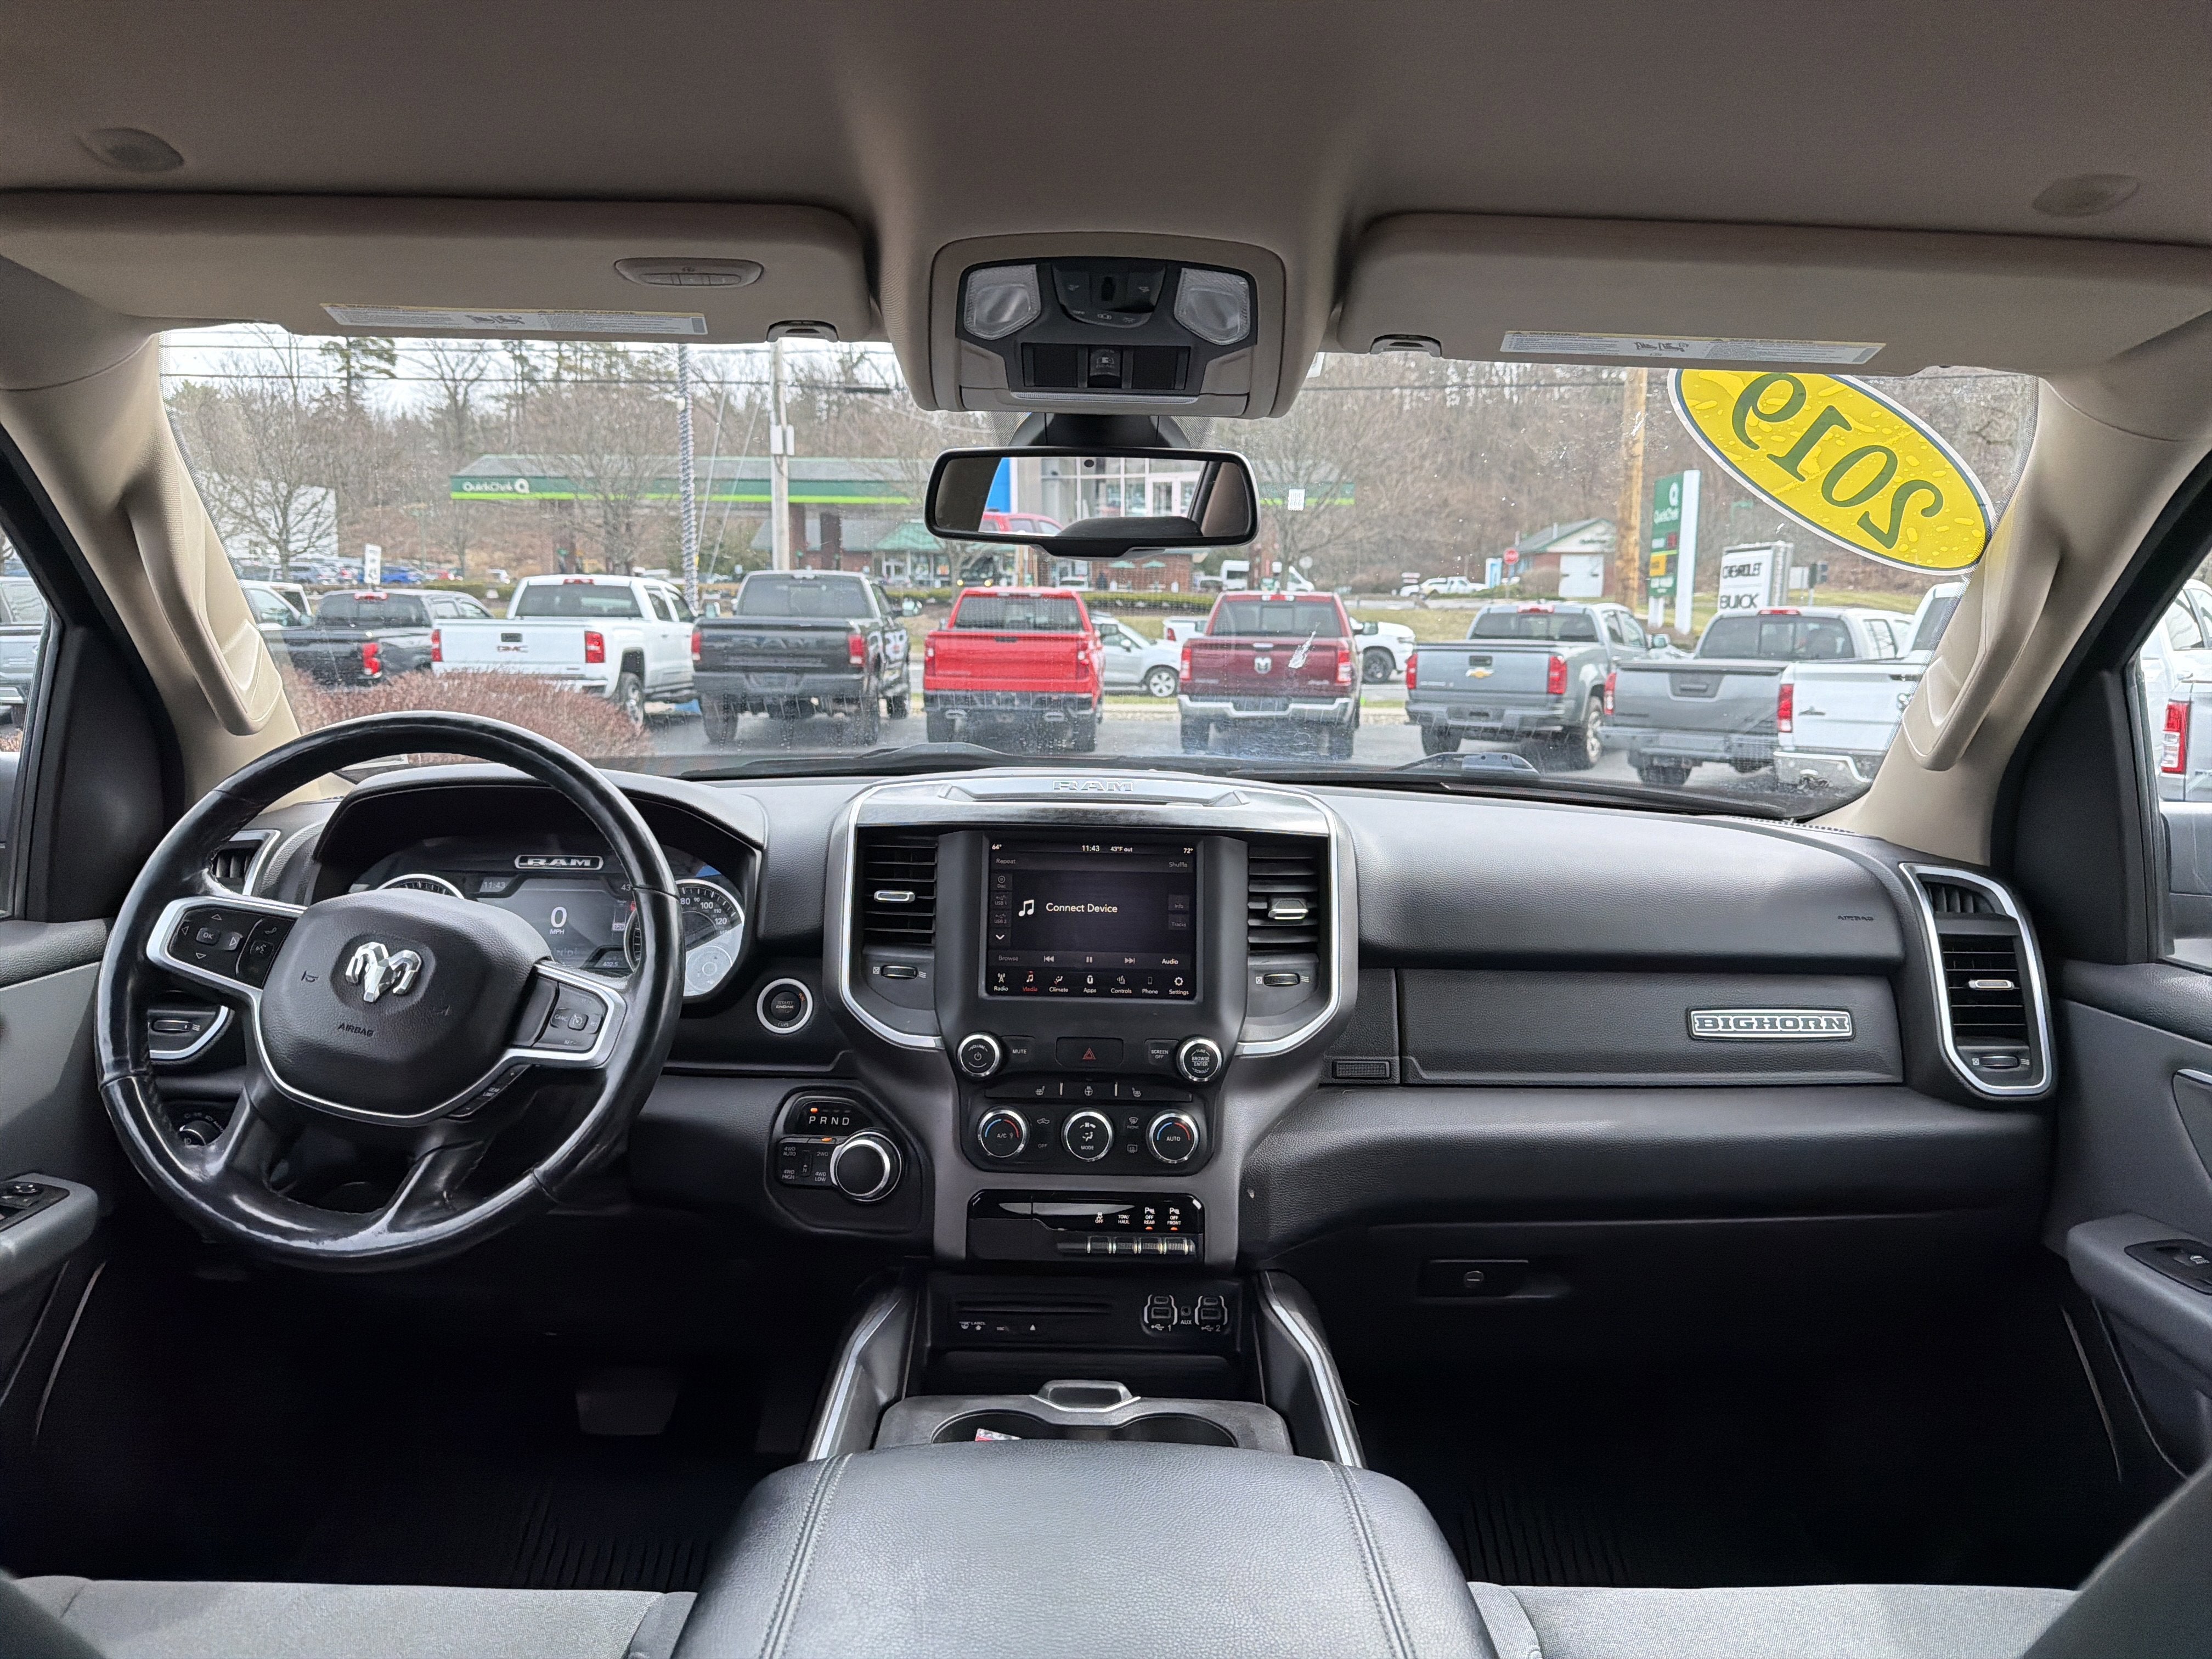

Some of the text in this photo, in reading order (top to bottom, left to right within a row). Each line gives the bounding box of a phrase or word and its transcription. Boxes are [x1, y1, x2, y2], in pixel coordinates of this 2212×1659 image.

[1053, 780, 1133, 791] RAM
[1046, 902, 1118, 913] Connect Device
[551, 906, 567, 928] 0
[1695, 1015, 1850, 1031] BIGHORN
[337, 1023, 374, 1037] AIRBAG
[809, 1116, 816, 1124] P
[820, 1116, 827, 1125] R
[831, 1117, 839, 1125] N
